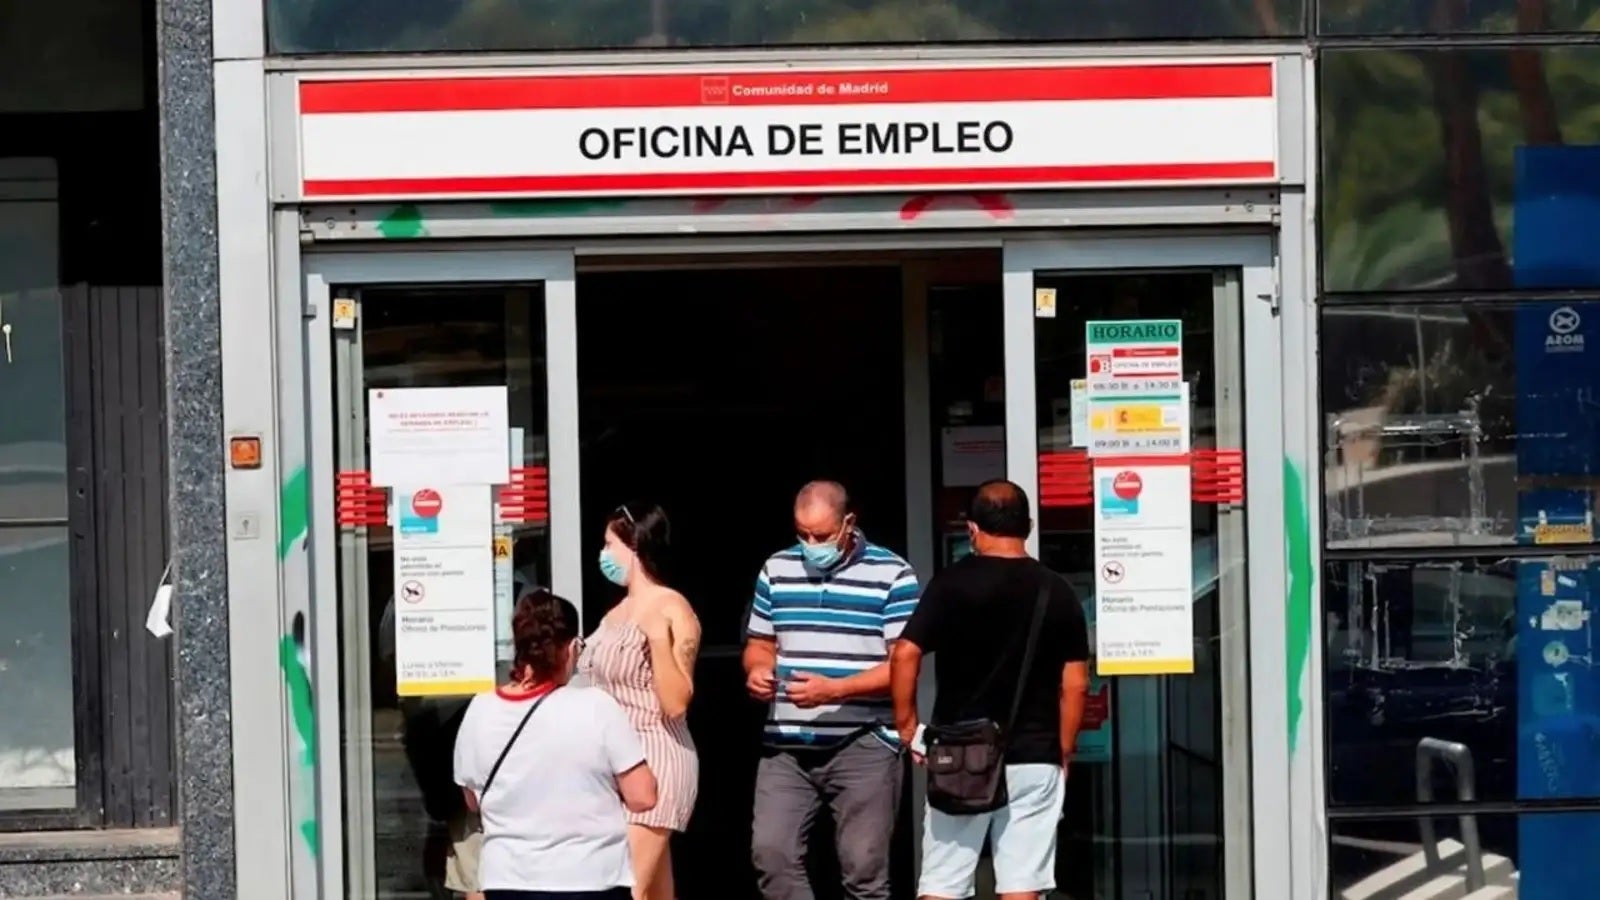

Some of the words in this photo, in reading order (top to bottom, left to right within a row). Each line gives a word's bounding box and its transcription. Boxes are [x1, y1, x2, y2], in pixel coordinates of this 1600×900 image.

[732, 83, 813, 97] Comunidad
[818, 83, 835, 95] de
[838, 81, 889, 95] Madrid
[578, 124, 754, 160] OFICINA
[767, 123, 824, 157] DE
[837, 120, 1014, 155] EMPLEO
[1093, 324, 1177, 339] HORARIO
